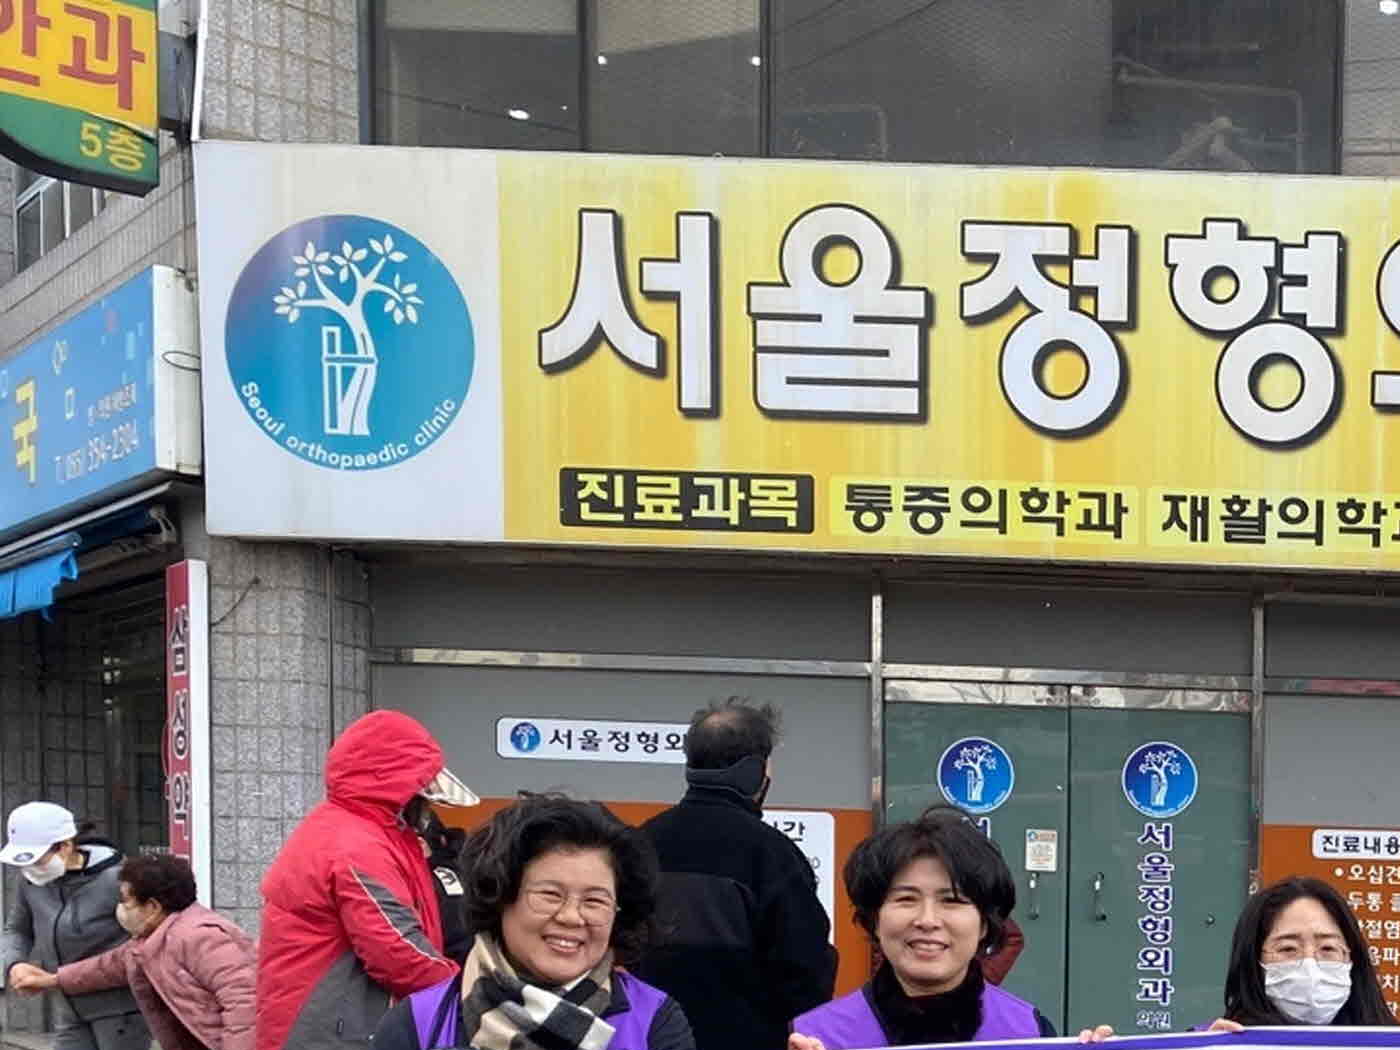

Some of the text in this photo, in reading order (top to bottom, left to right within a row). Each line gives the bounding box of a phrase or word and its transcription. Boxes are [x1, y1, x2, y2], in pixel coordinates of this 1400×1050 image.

[80, 121, 146, 172] 5층
[241, 381, 456, 470] Seoul orthopaedic clinic
[577, 473, 799, 528] 진료과목
[845, 484, 1130, 538] 통증의학과
[1136, 823, 1175, 1005] 서울정형외과
[1347, 891, 1383, 912] 두통
[1136, 1009, 1172, 1030] 의원
